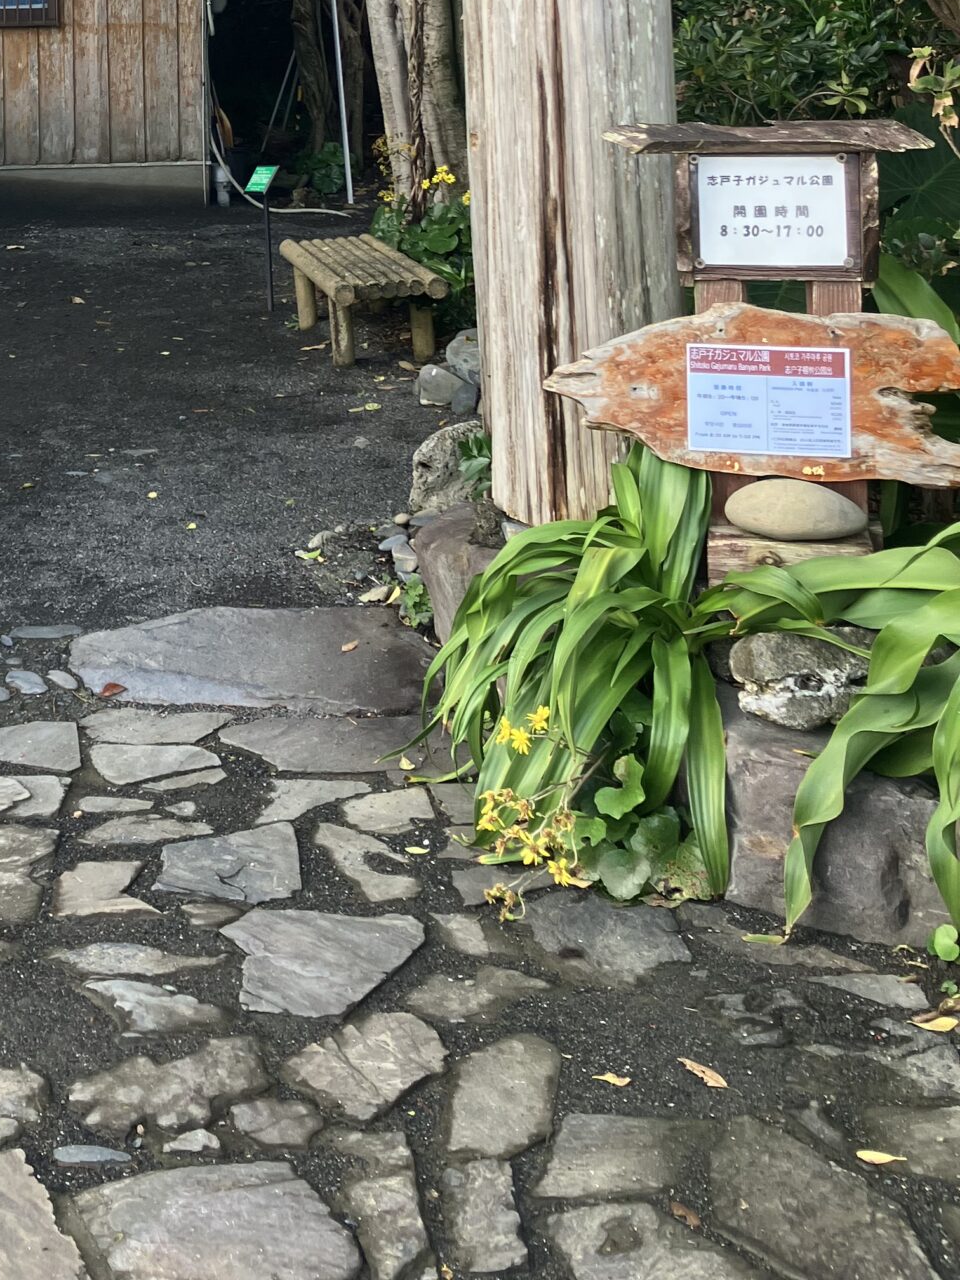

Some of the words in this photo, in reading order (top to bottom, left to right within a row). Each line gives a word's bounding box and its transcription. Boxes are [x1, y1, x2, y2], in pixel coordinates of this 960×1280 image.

[706, 175, 834, 187] 志戸子ガジュマル公園
[733, 205, 809, 218] 開園時間
[690, 348, 770, 362] 志戸子ガジュマル公園
[738, 363, 758, 372] Banyan
[759, 364, 771, 372] Park
